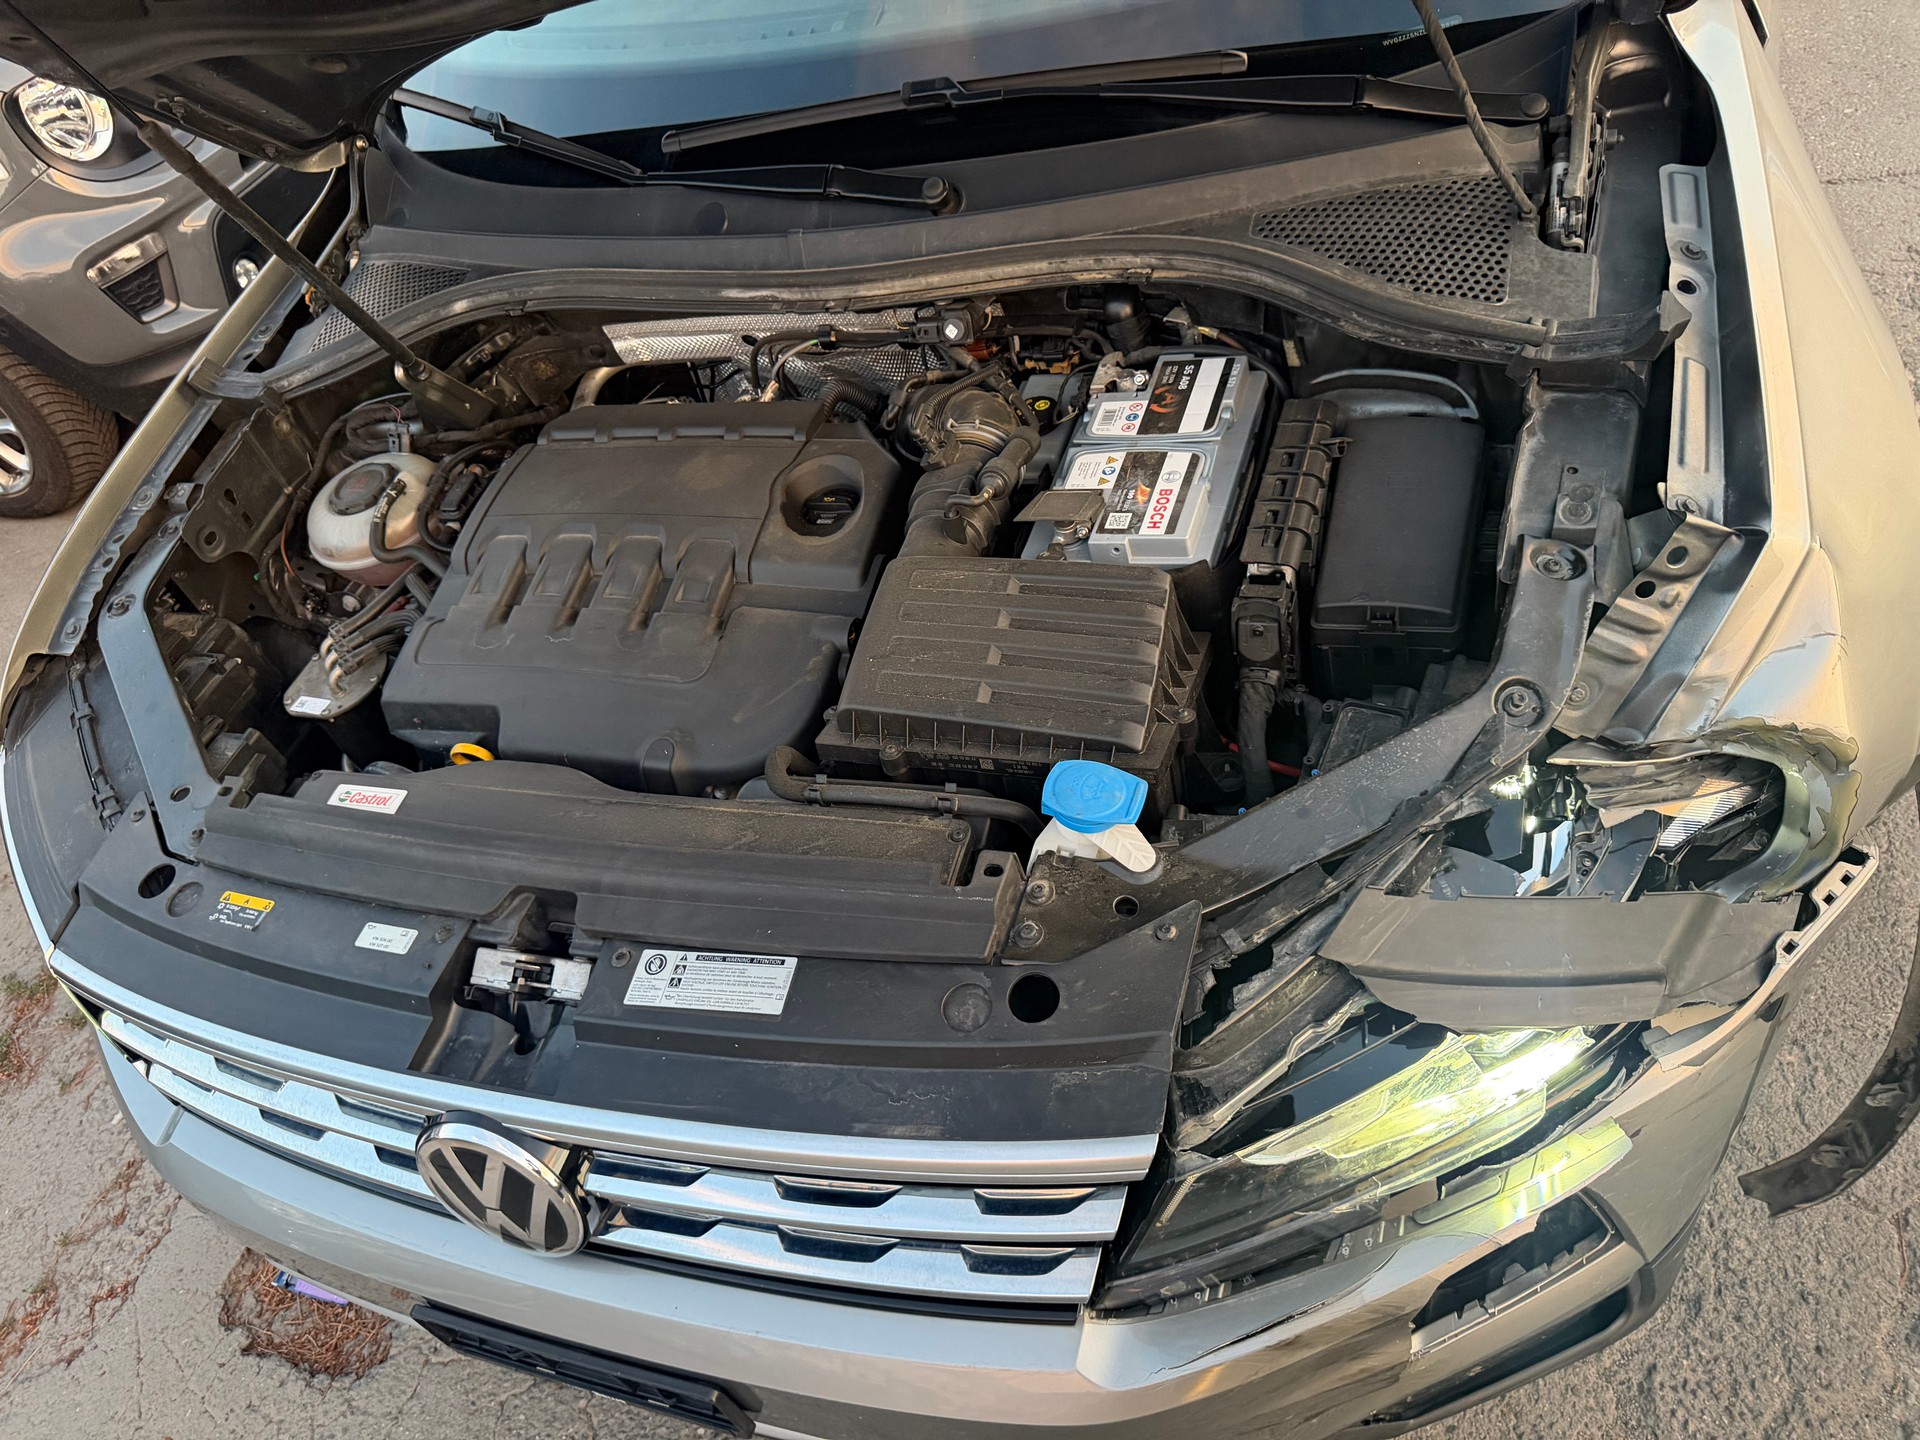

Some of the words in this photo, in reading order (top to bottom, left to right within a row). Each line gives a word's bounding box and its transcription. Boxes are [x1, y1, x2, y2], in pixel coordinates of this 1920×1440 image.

[1183, 364, 1195, 375] S5
[1178, 375, 1192, 390] A08
[1147, 488, 1174, 529] BOSCH
[349, 791, 393, 806] Castrol
[418, 1134, 584, 1255] VW
